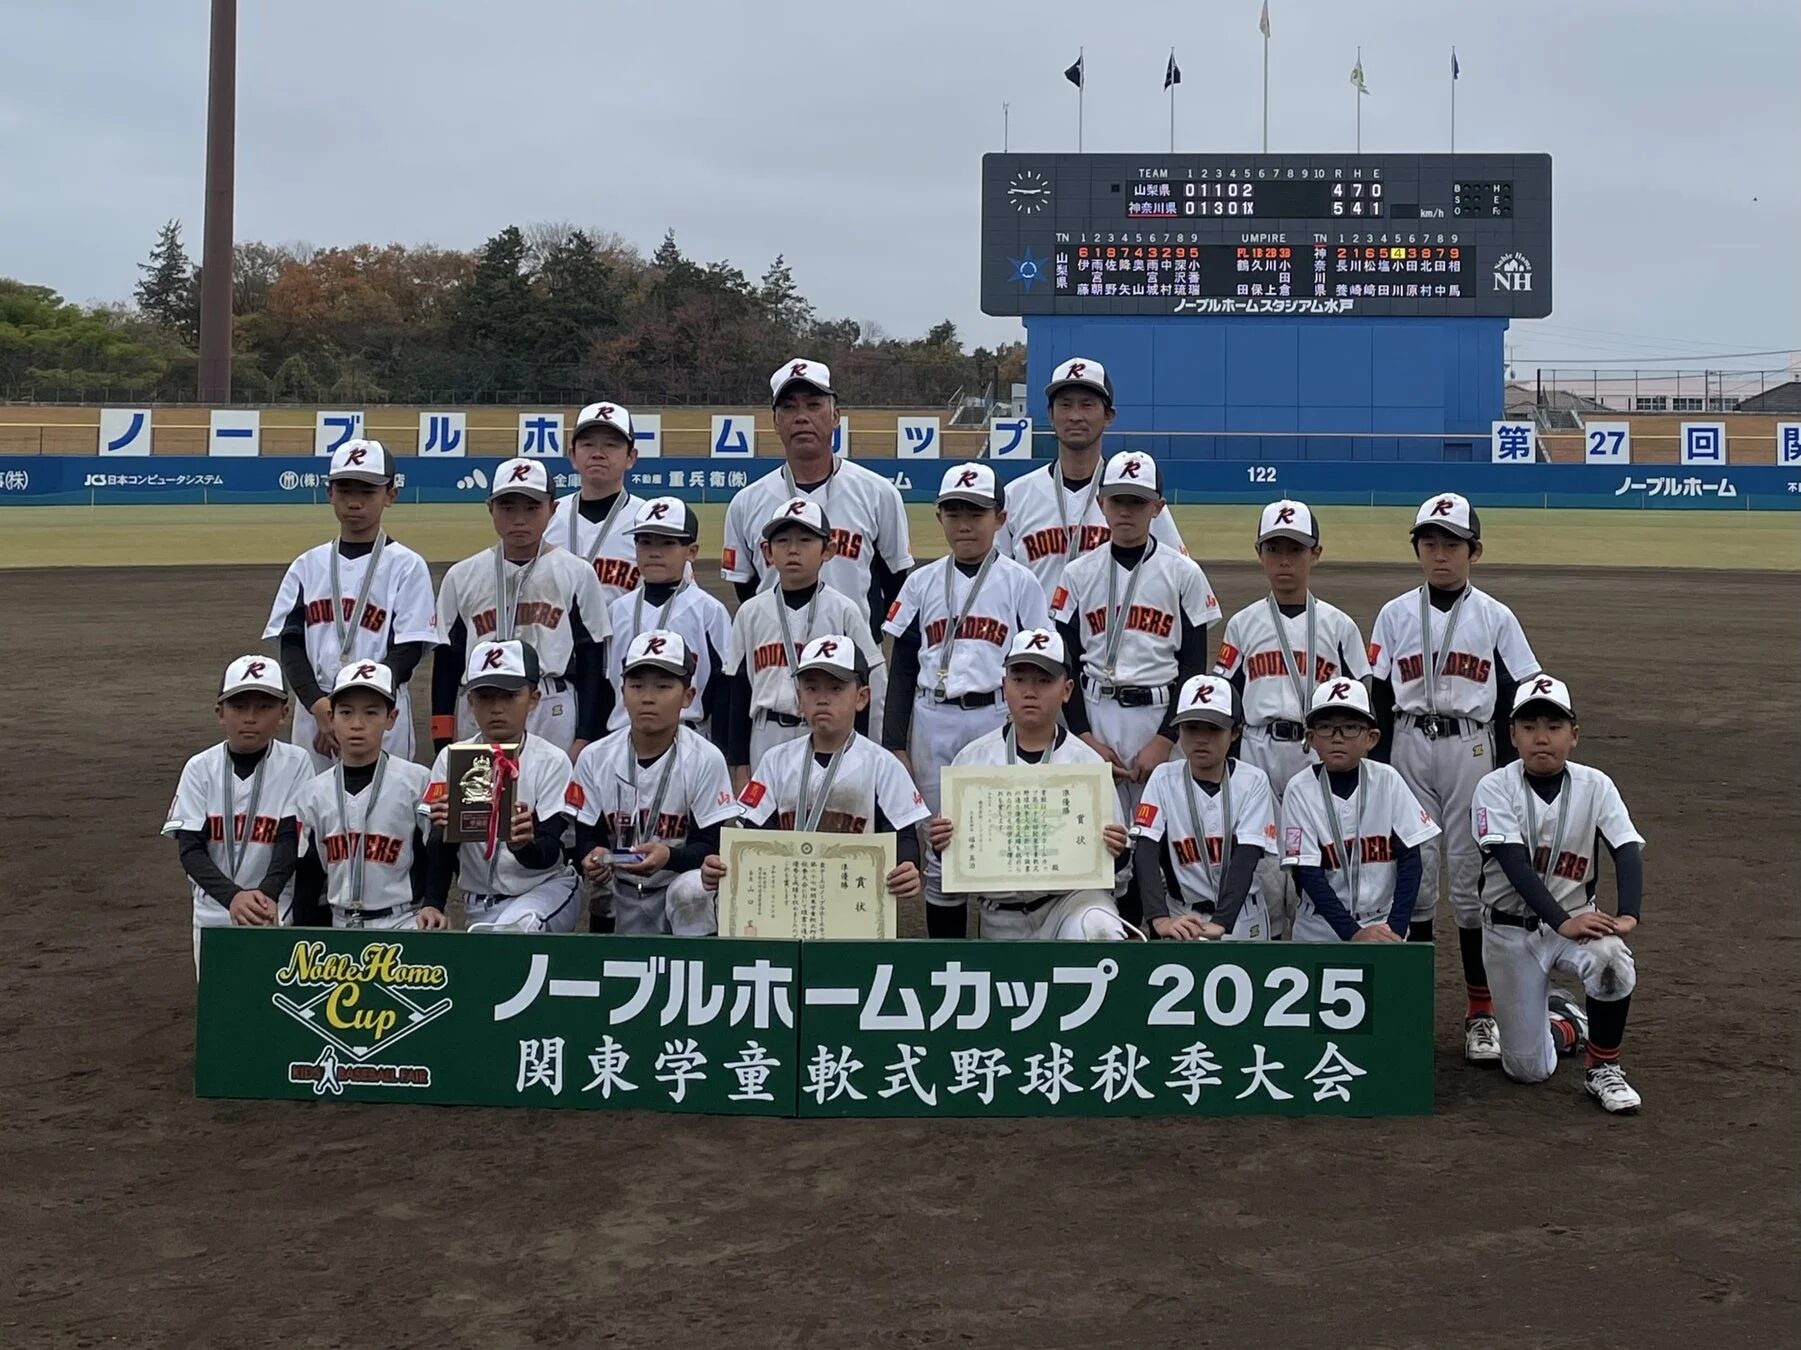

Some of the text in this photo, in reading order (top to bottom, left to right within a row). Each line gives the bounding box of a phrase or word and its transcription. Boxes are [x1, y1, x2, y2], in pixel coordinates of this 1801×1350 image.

[1139, 169, 1379, 178] TEAM 1 2 3 4 5 6 7 8 9 10 R H E
[1134, 184, 1381, 197] 山梨県 0 1 1 0 2 4 7 0
[1128, 202, 1379, 215] 神奈川県 0 1 3 0 1X 5 4 1
[1421, 208, 1444, 218] km/h
[1056, 233, 1197, 242] TN 1 2 3 4 5 6 7 8 9
[1242, 234, 1286, 242] UMPIRE
[1314, 234, 1458, 242] TN 1 2 3 4 5 6 7 8 9
[1079, 248, 1198, 257] 6 1 8 7 4 3 2 9 5
[1337, 248, 1346, 258] 2
[1354, 248, 1358, 258] 1
[1366, 248, 1374, 258] 6
[1380, 248, 1388, 258] 5
[1408, 248, 1416, 258] 3
[1422, 248, 1430, 258] 8
[1436, 248, 1444, 258] 7
[1450, 248, 1459, 258] 9
[1056, 252, 1068, 288] 山梨県
[1160, 260, 1172, 295] 中村
[1252, 260, 1263, 296] 久保
[1265, 260, 1277, 296] 川上
[1314, 248, 1326, 296] 神奈川県
[1392, 260, 1403, 296] 小川
[1420, 260, 1432, 296] 北村
[1434, 260, 1446, 296] 田中
[1493, 272, 1532, 291] NH
[1174, 298, 1354, 313] ノーブルホームスタジアム水戸
[790, 363, 808, 377] R
[1066, 363, 1086, 379] R
[1497, 425, 1531, 460] 第
[1589, 431, 1626, 455] 27
[1687, 428, 1719, 460] 回
[344, 448, 367, 467] R
[508, 464, 531, 483] R
[1119, 460, 1141, 479] R
[1247, 466, 1276, 482] 122
[108, 475, 223, 485] 日本コンピュータシステム
[1615, 477, 1737, 496] ノーブルホーム
[1274, 507, 1295, 526] R
[481, 648, 504, 671] R
[278, 942, 444, 984] Noble Home
[494, 954, 1366, 1031] ノーブルホームカップ 2025
[326, 982, 396, 1040] Cup
[516, 1034, 1367, 1106] 関東学童軟式野球秋季大会
